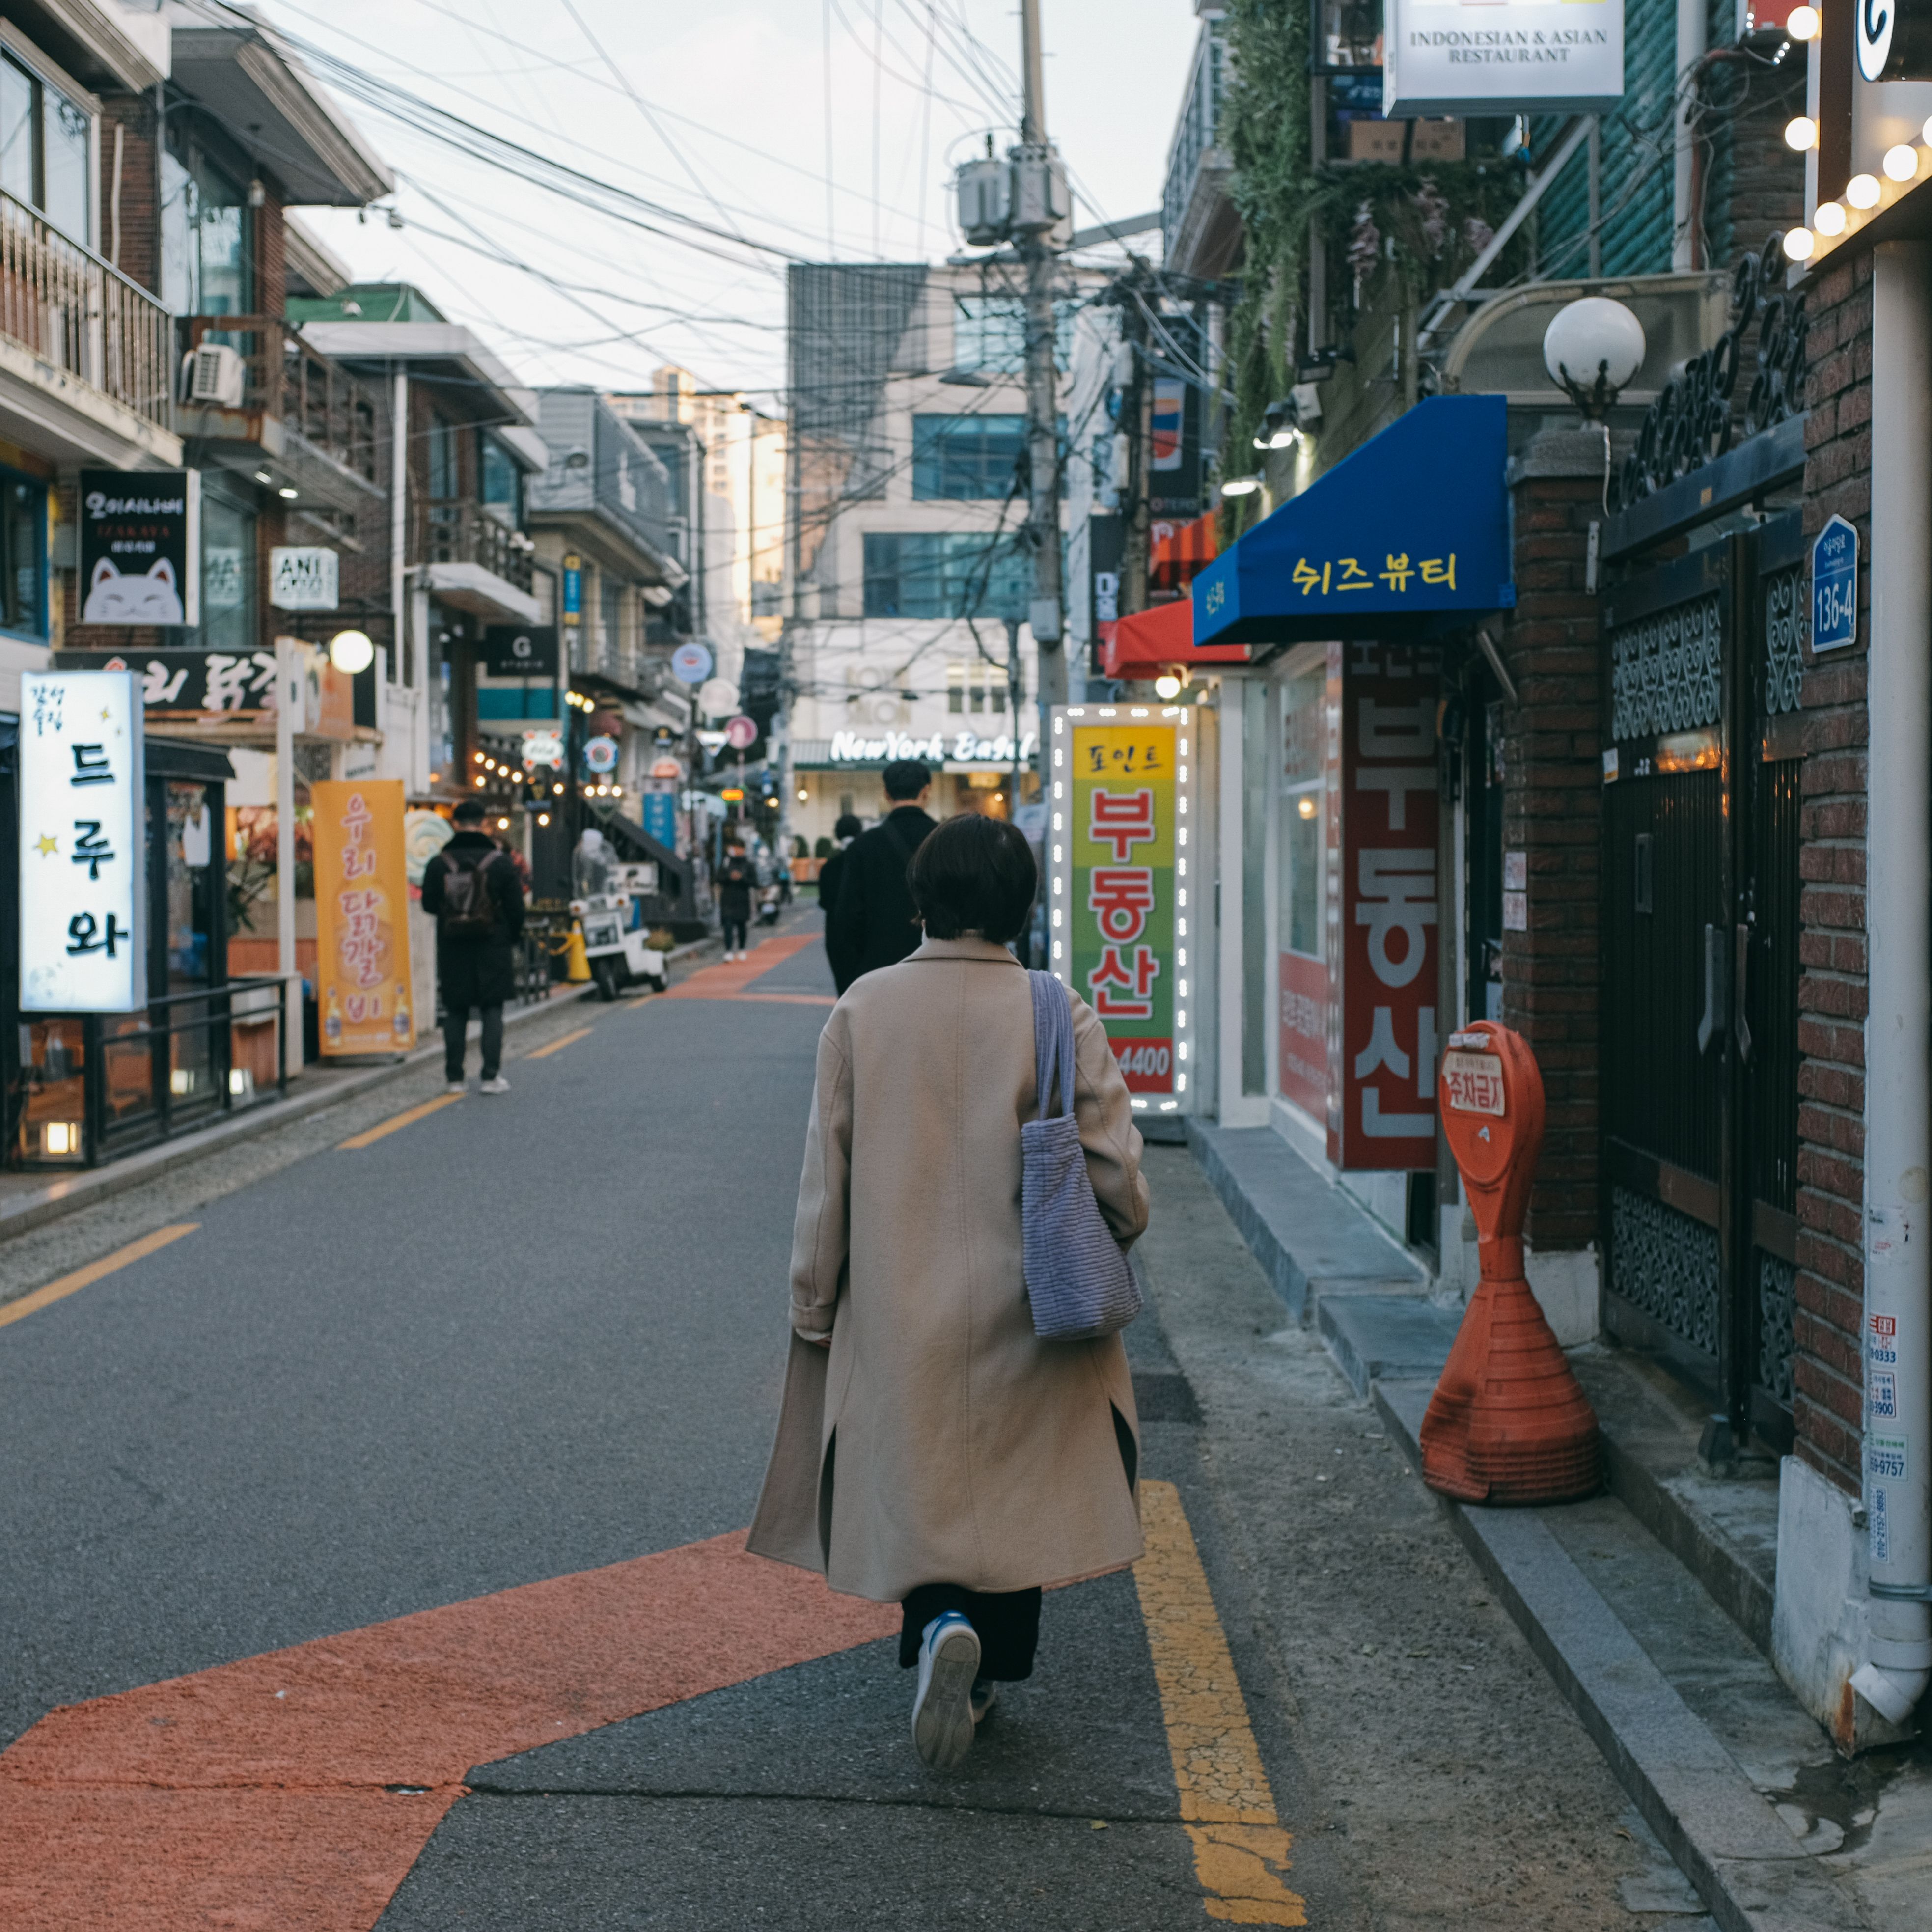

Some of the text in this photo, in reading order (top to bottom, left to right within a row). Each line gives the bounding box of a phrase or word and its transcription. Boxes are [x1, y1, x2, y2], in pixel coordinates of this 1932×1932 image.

[1410, 28, 1607, 47] INDONESIAN & ASIAN
[1449, 48, 1571, 64] RESTAURANT
[1817, 579, 1853, 633] 136-4
[512, 635, 532, 658] G
[1088, 745, 1163, 773] 포인트
[66, 744, 129, 958] 드루와
[1088, 788, 1159, 1020] 부동산
[1354, 697, 1438, 1138] 부동산
[1450, 1071, 1499, 1108] 주차금지
